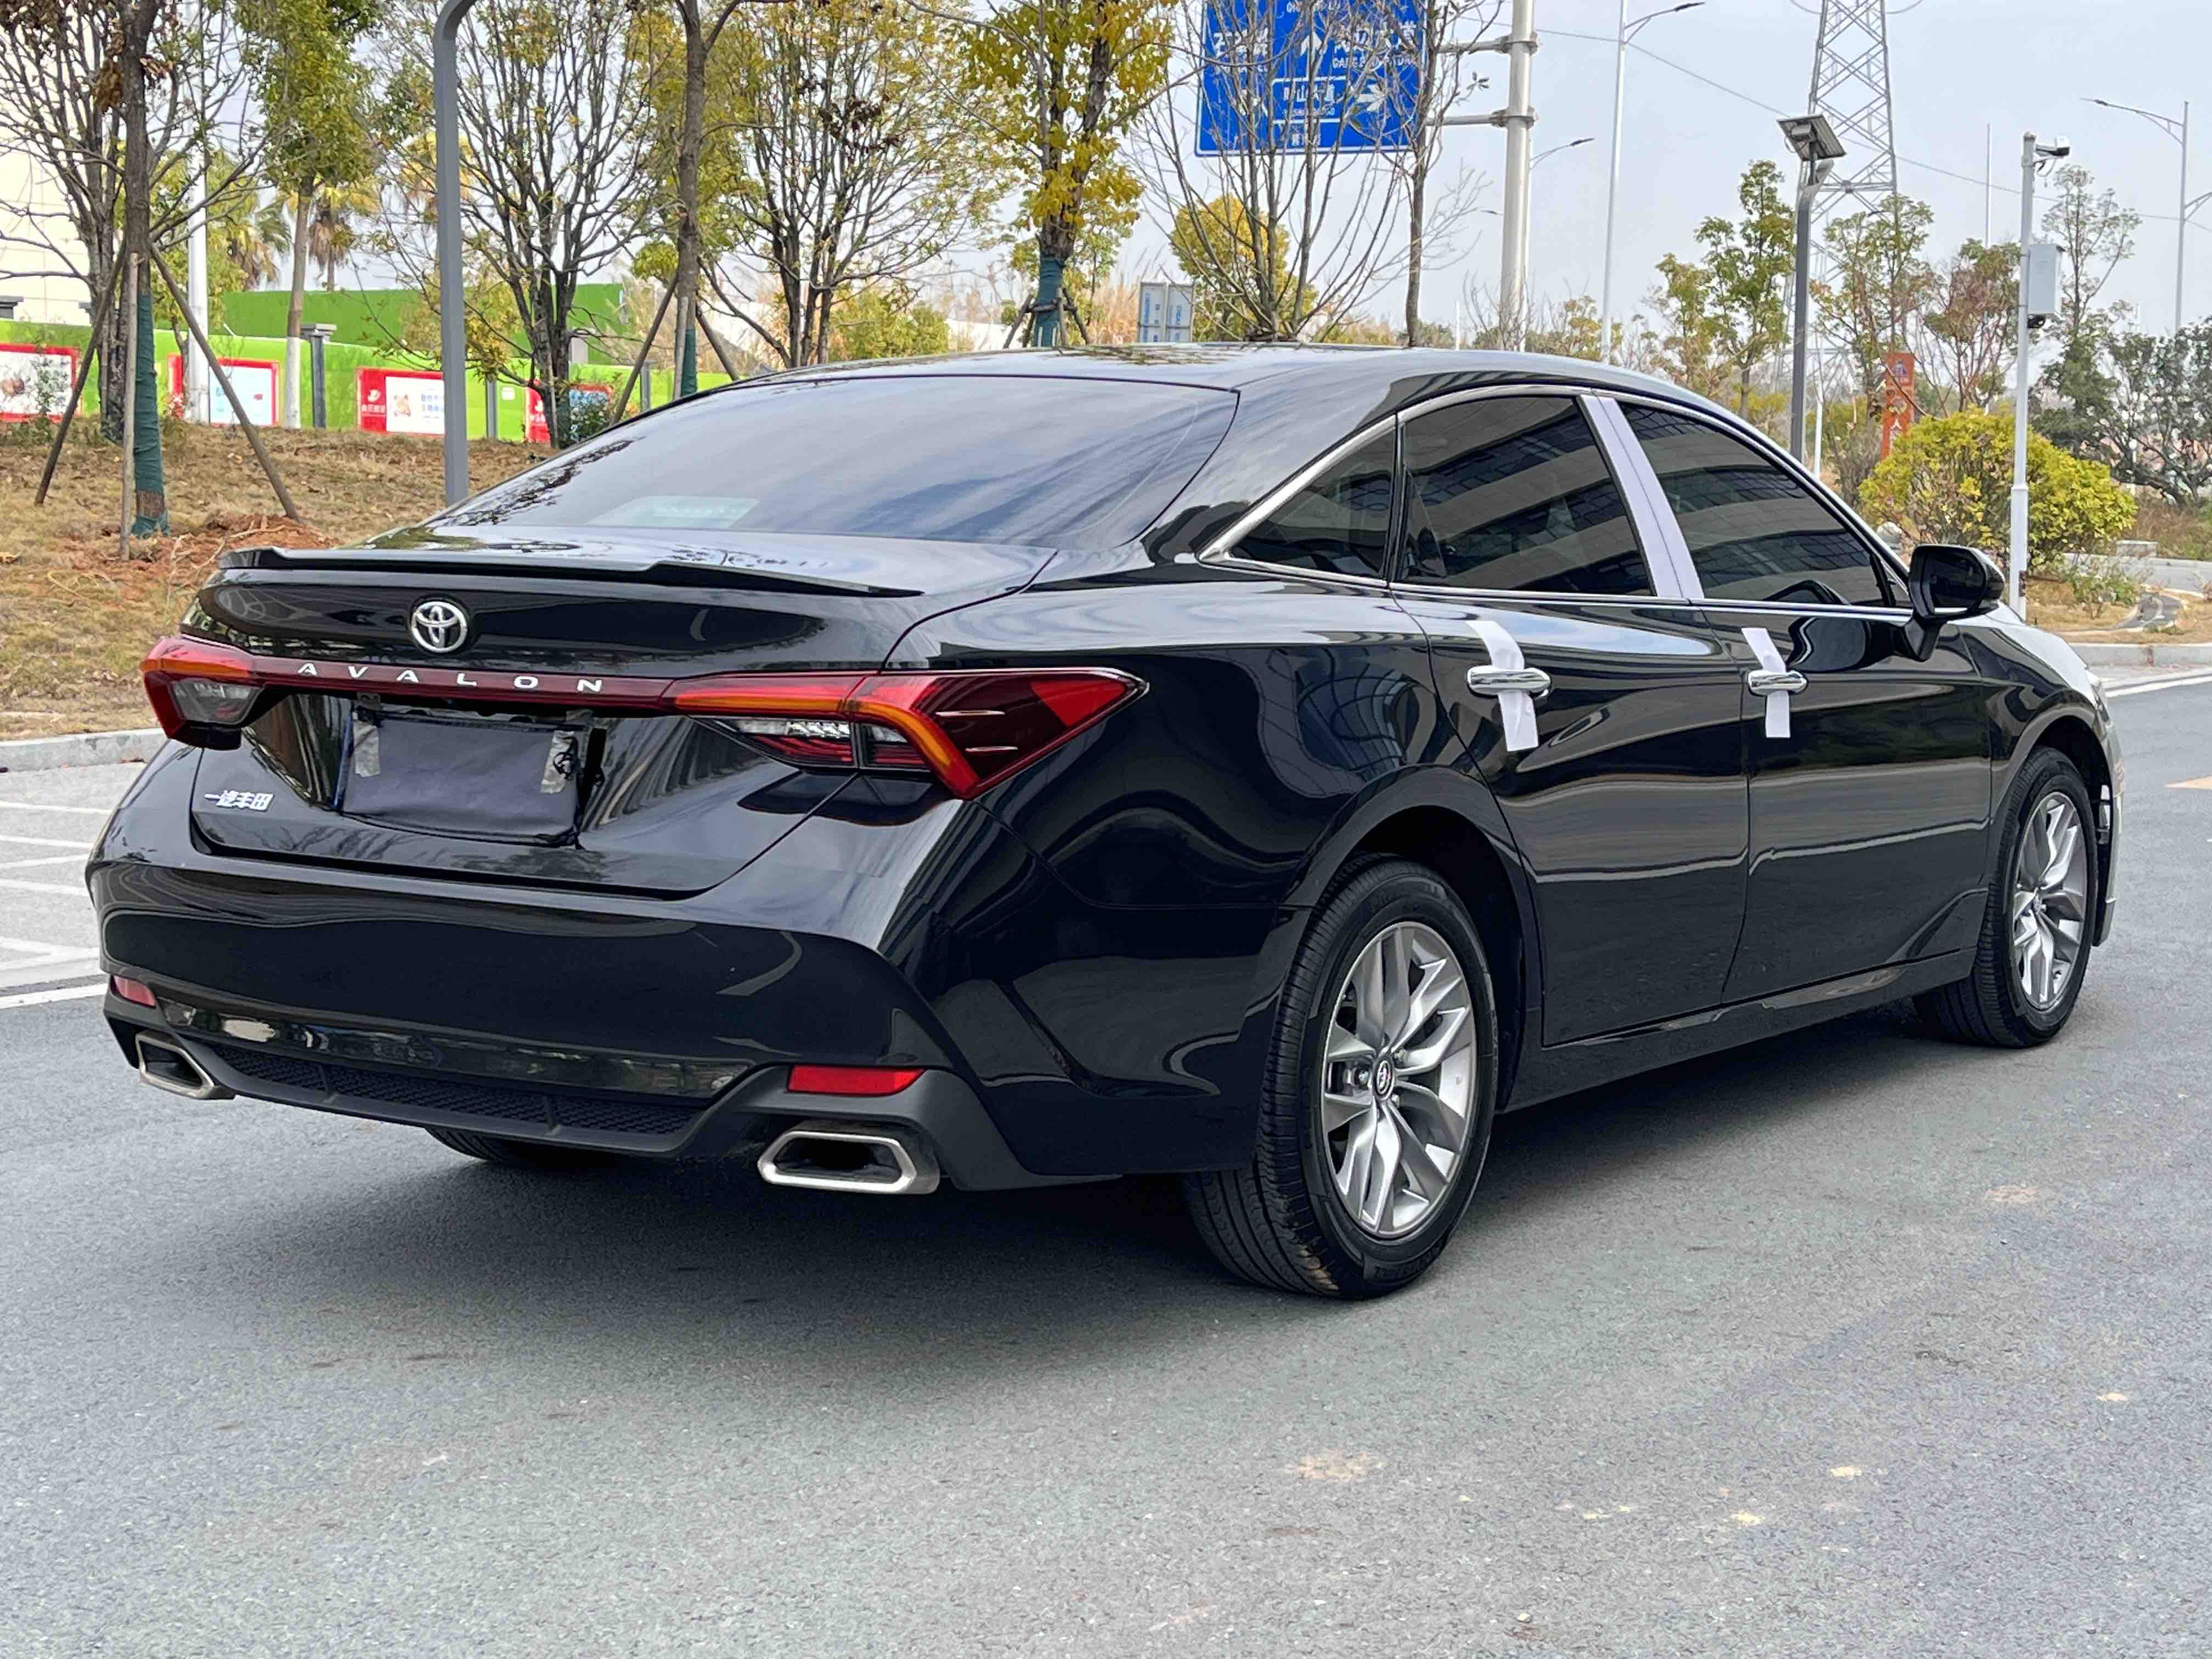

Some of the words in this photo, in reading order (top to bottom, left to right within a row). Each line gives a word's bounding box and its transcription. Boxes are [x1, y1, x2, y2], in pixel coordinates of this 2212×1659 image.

[297, 662, 602, 693] AVALON
[204, 790, 274, 811] 一汽丰田
